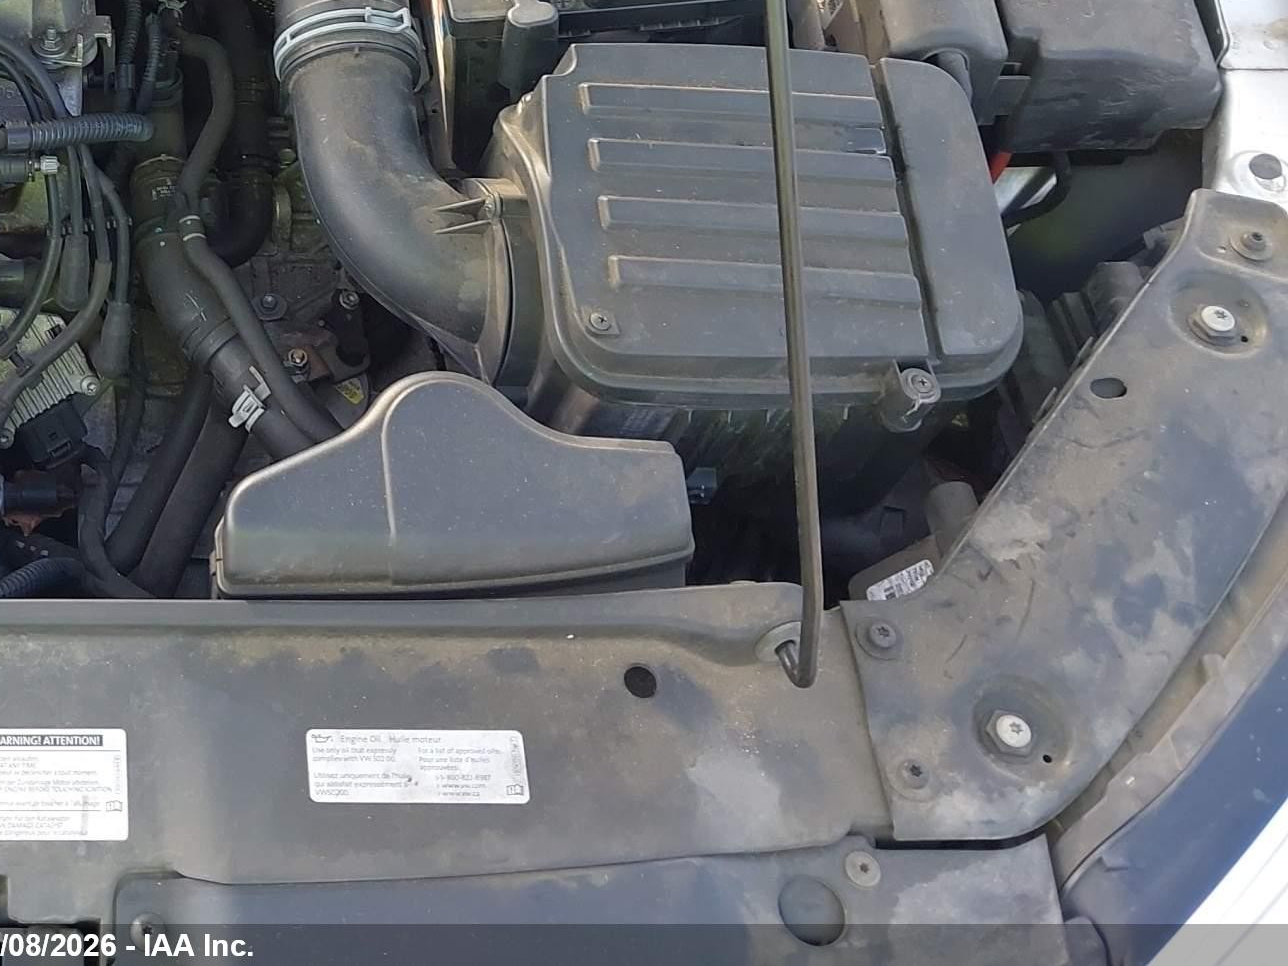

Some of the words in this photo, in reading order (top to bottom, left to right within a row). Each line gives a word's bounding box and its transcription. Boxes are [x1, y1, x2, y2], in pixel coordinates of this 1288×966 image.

[42, 735, 101, 746] ATTENTION!
[340, 735, 368, 745] Engine
[389, 735, 410, 745] Huile
[411, 735, 441, 745] moteur
